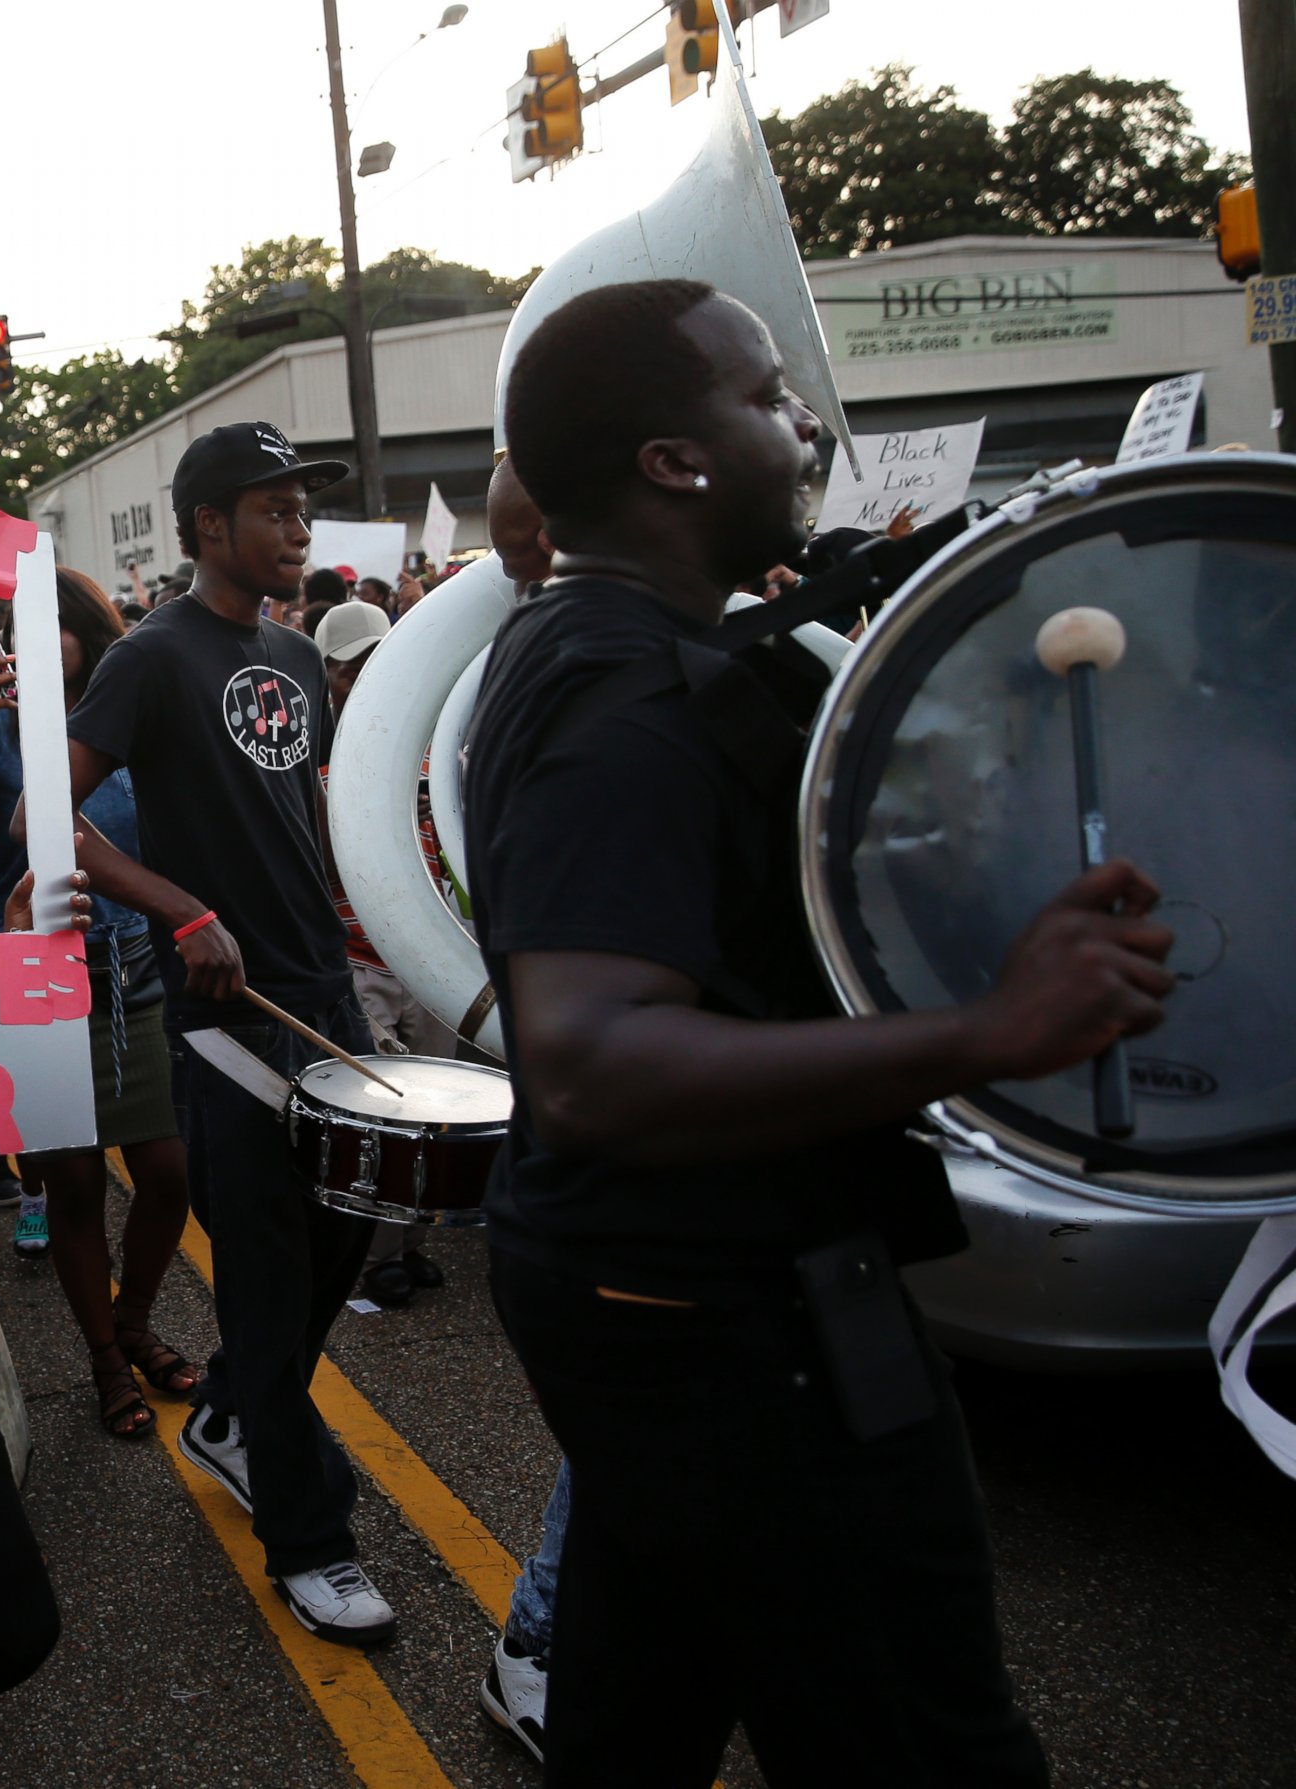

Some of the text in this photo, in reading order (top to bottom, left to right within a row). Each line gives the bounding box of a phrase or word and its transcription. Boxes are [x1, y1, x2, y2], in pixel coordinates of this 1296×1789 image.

[881, 270, 1073, 321] BIG BEN
[991, 323, 1109, 345] GOBIGBEN.COM
[878, 432, 948, 464] Black
[882, 469, 937, 491] Lives
[110, 502, 153, 545] BIG BEN
[854, 498, 935, 526] Matr
[237, 728, 277, 769] LAST
